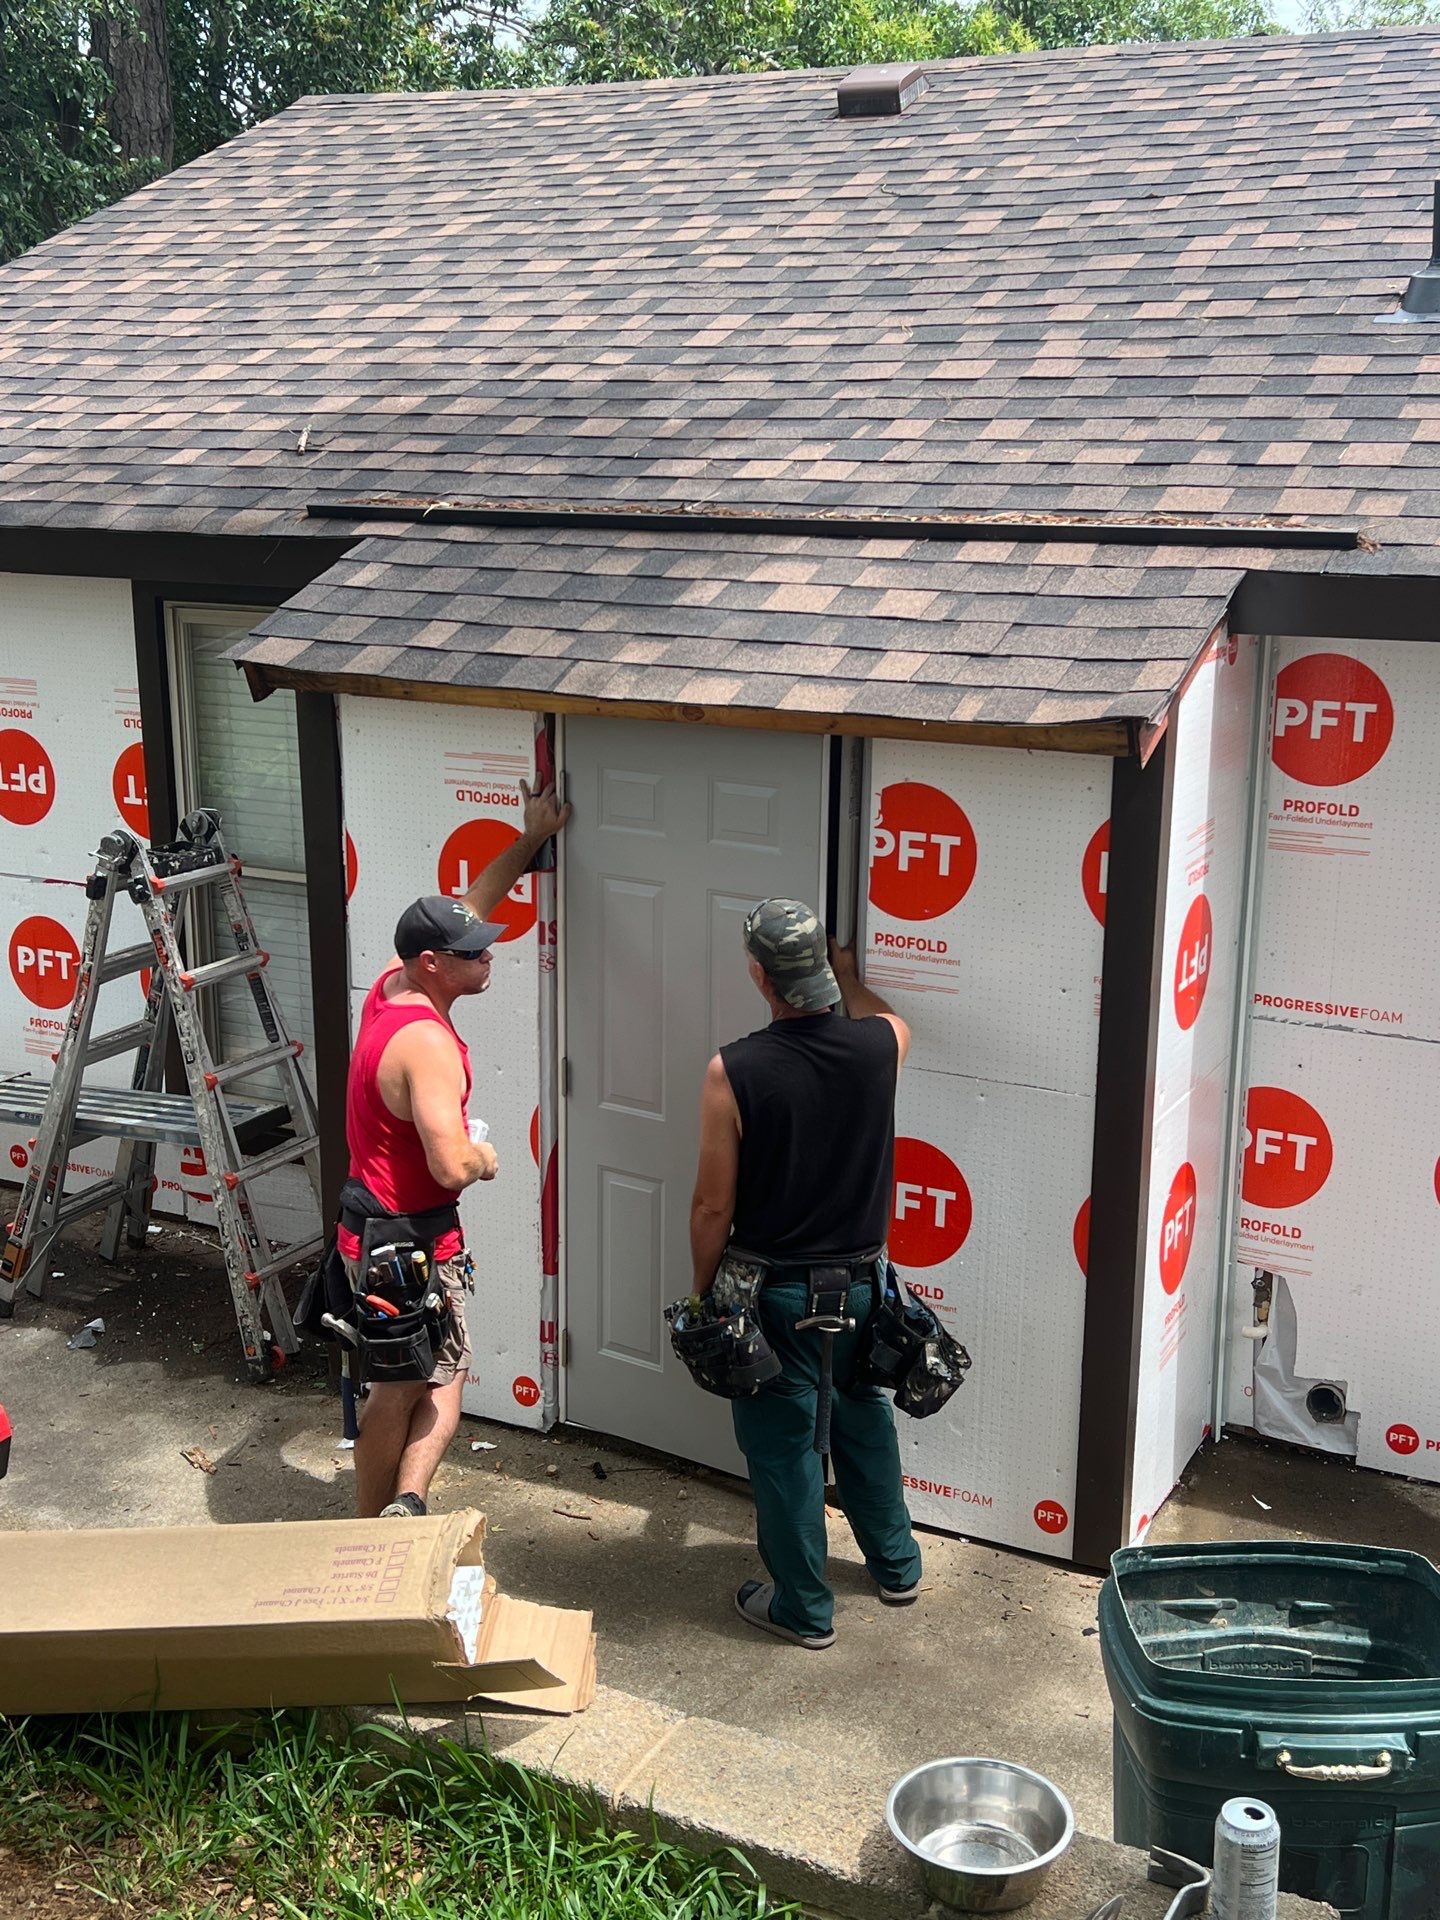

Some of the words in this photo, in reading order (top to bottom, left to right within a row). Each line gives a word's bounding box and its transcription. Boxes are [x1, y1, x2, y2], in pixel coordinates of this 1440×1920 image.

[0, 708, 33, 719] PROFO
[1274, 698, 1378, 743] PFT
[456, 789, 519, 806] PROFOLD
[1283, 799, 1360, 817] PROFOLD
[1315, 817, 1373, 829] Underlayment
[868, 828, 962, 876] PFT
[874, 932, 948, 953] PROFOLD
[16, 945, 73, 980] PFT
[1178, 933, 1210, 993] PFT
[1254, 993, 1404, 1024] PROGRESSIVEFOAM
[30, 1016, 66, 1032] PROFOL
[895, 1181, 956, 1228] FT
[1163, 1195, 1193, 1263] PFT
[1240, 1217, 1302, 1240] ROFOLD
[515, 1384, 536, 1398] PFT
[1389, 1431, 1417, 1446] PFT
[902, 1474, 993, 1508] ESSIVEFOAM
[1037, 1509, 1063, 1524] PFT
